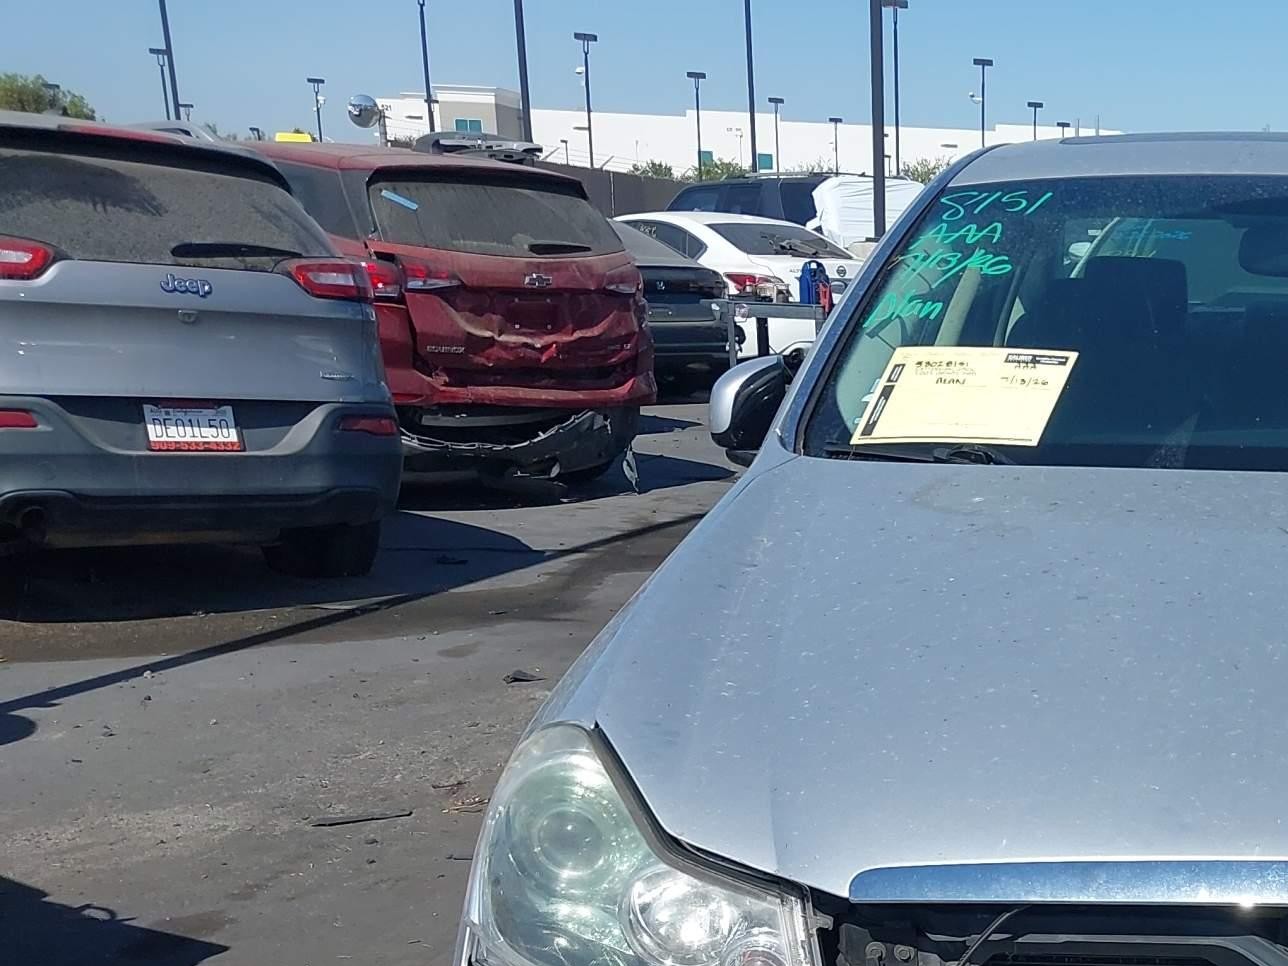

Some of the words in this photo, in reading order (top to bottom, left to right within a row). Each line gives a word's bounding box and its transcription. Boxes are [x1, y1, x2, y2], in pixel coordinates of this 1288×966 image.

[908, 222, 1002, 250] AAA
[160, 273, 212, 298] Jeep
[152, 418, 230, 439] DE01L50
